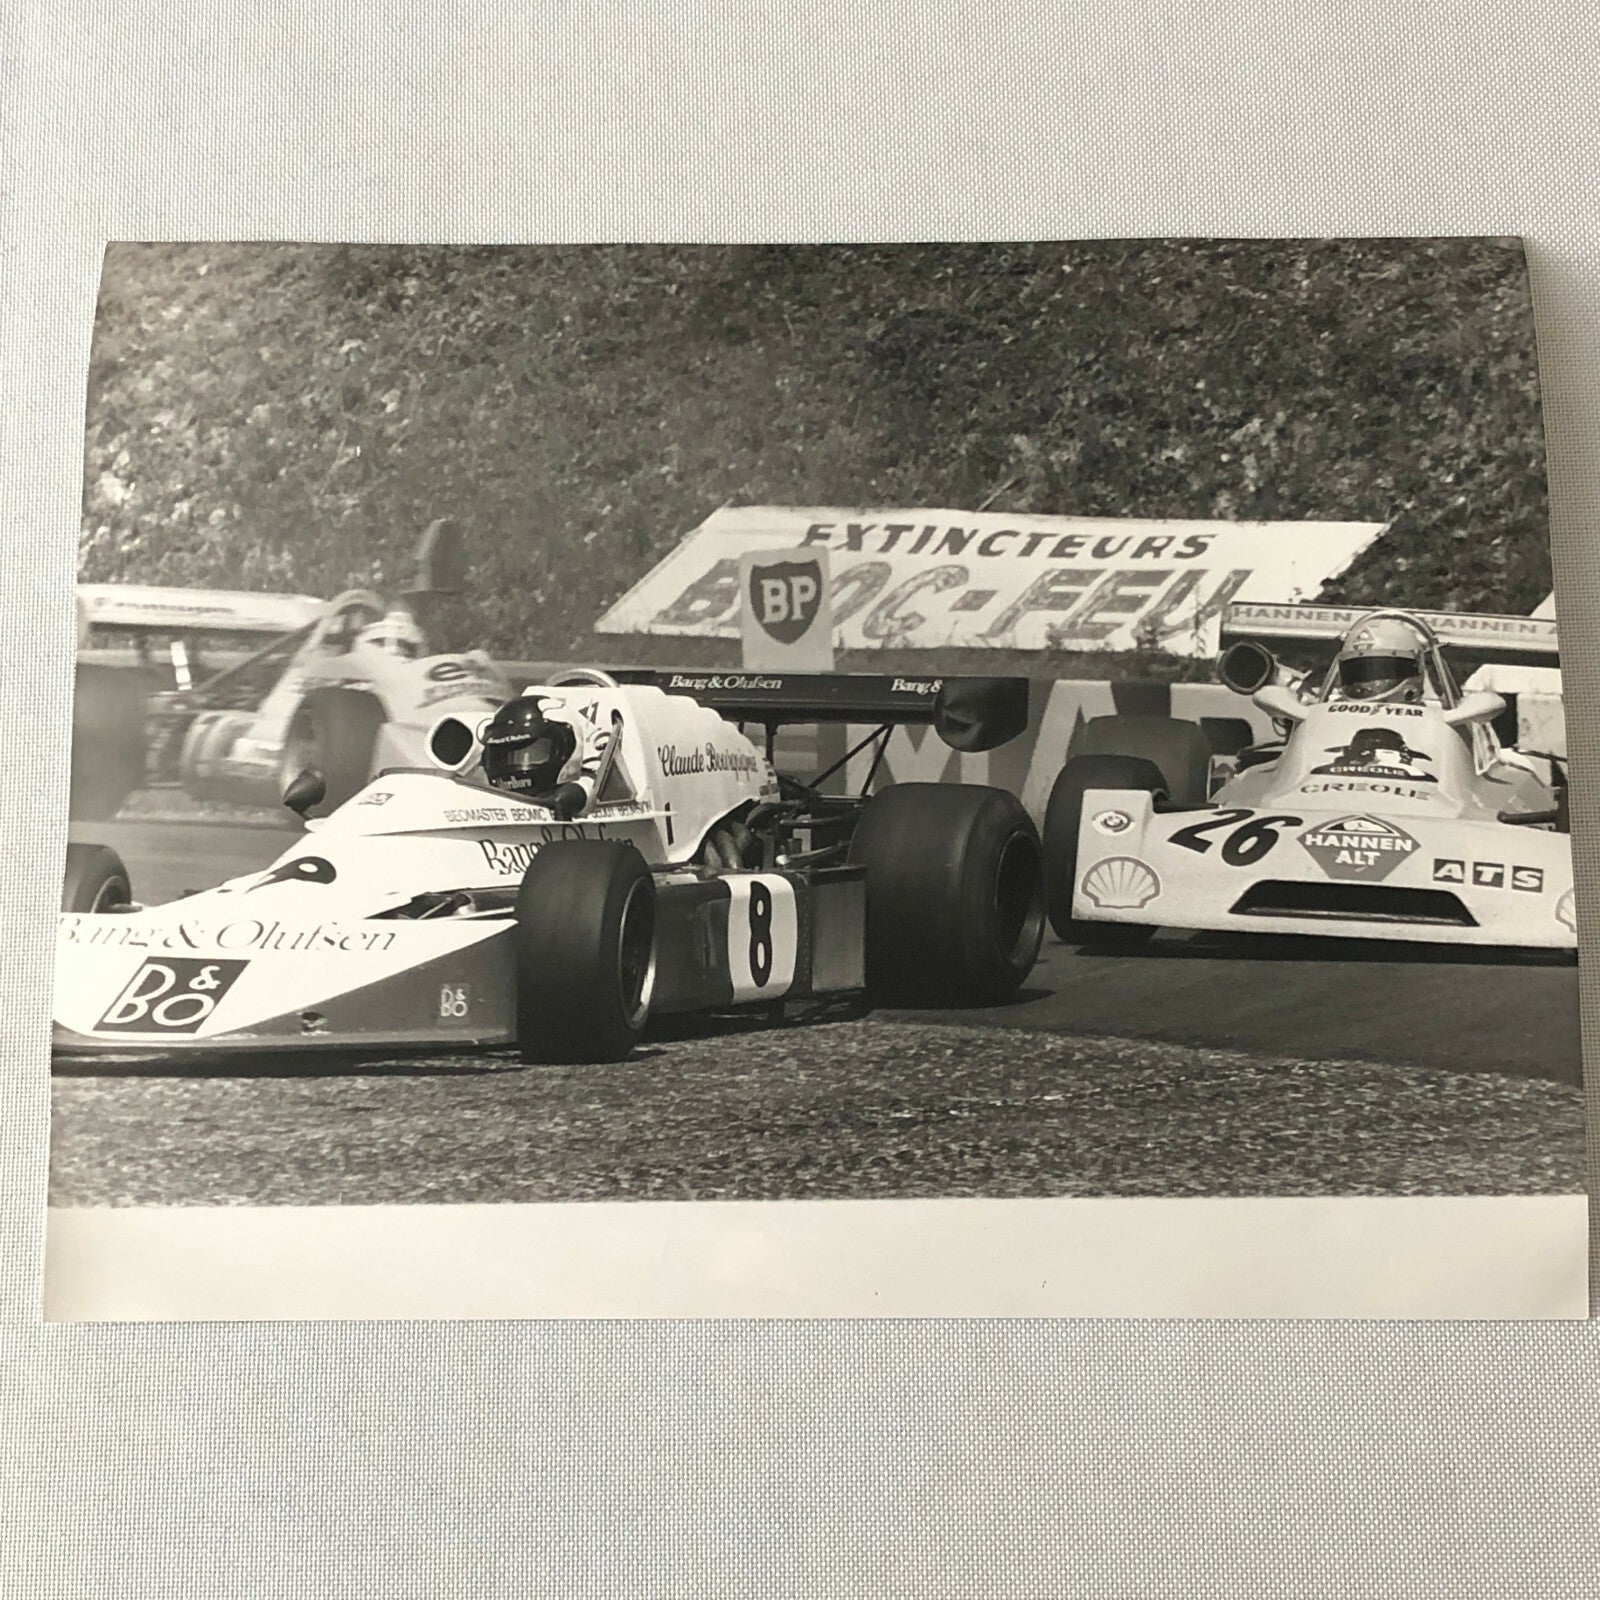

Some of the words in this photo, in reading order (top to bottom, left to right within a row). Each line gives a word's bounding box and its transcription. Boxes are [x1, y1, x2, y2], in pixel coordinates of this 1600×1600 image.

[797, 523, 1218, 559] EXTINCTEURS
[760, 574, 818, 624] BP
[1233, 606, 1353, 622] HANNEN
[891, 678, 931, 696] Bang
[1328, 704, 1371, 714] GOOD
[1385, 707, 1424, 718] YEAR
[657, 744, 705, 778] Claude
[1167, 809, 1304, 867] 26
[1304, 833, 1413, 851] HANNEN
[1335, 851, 1381, 867] ALT
[1434, 861, 1543, 890] ATS
[216, 919, 397, 951] Olufsen
[748, 880, 773, 988] 8
